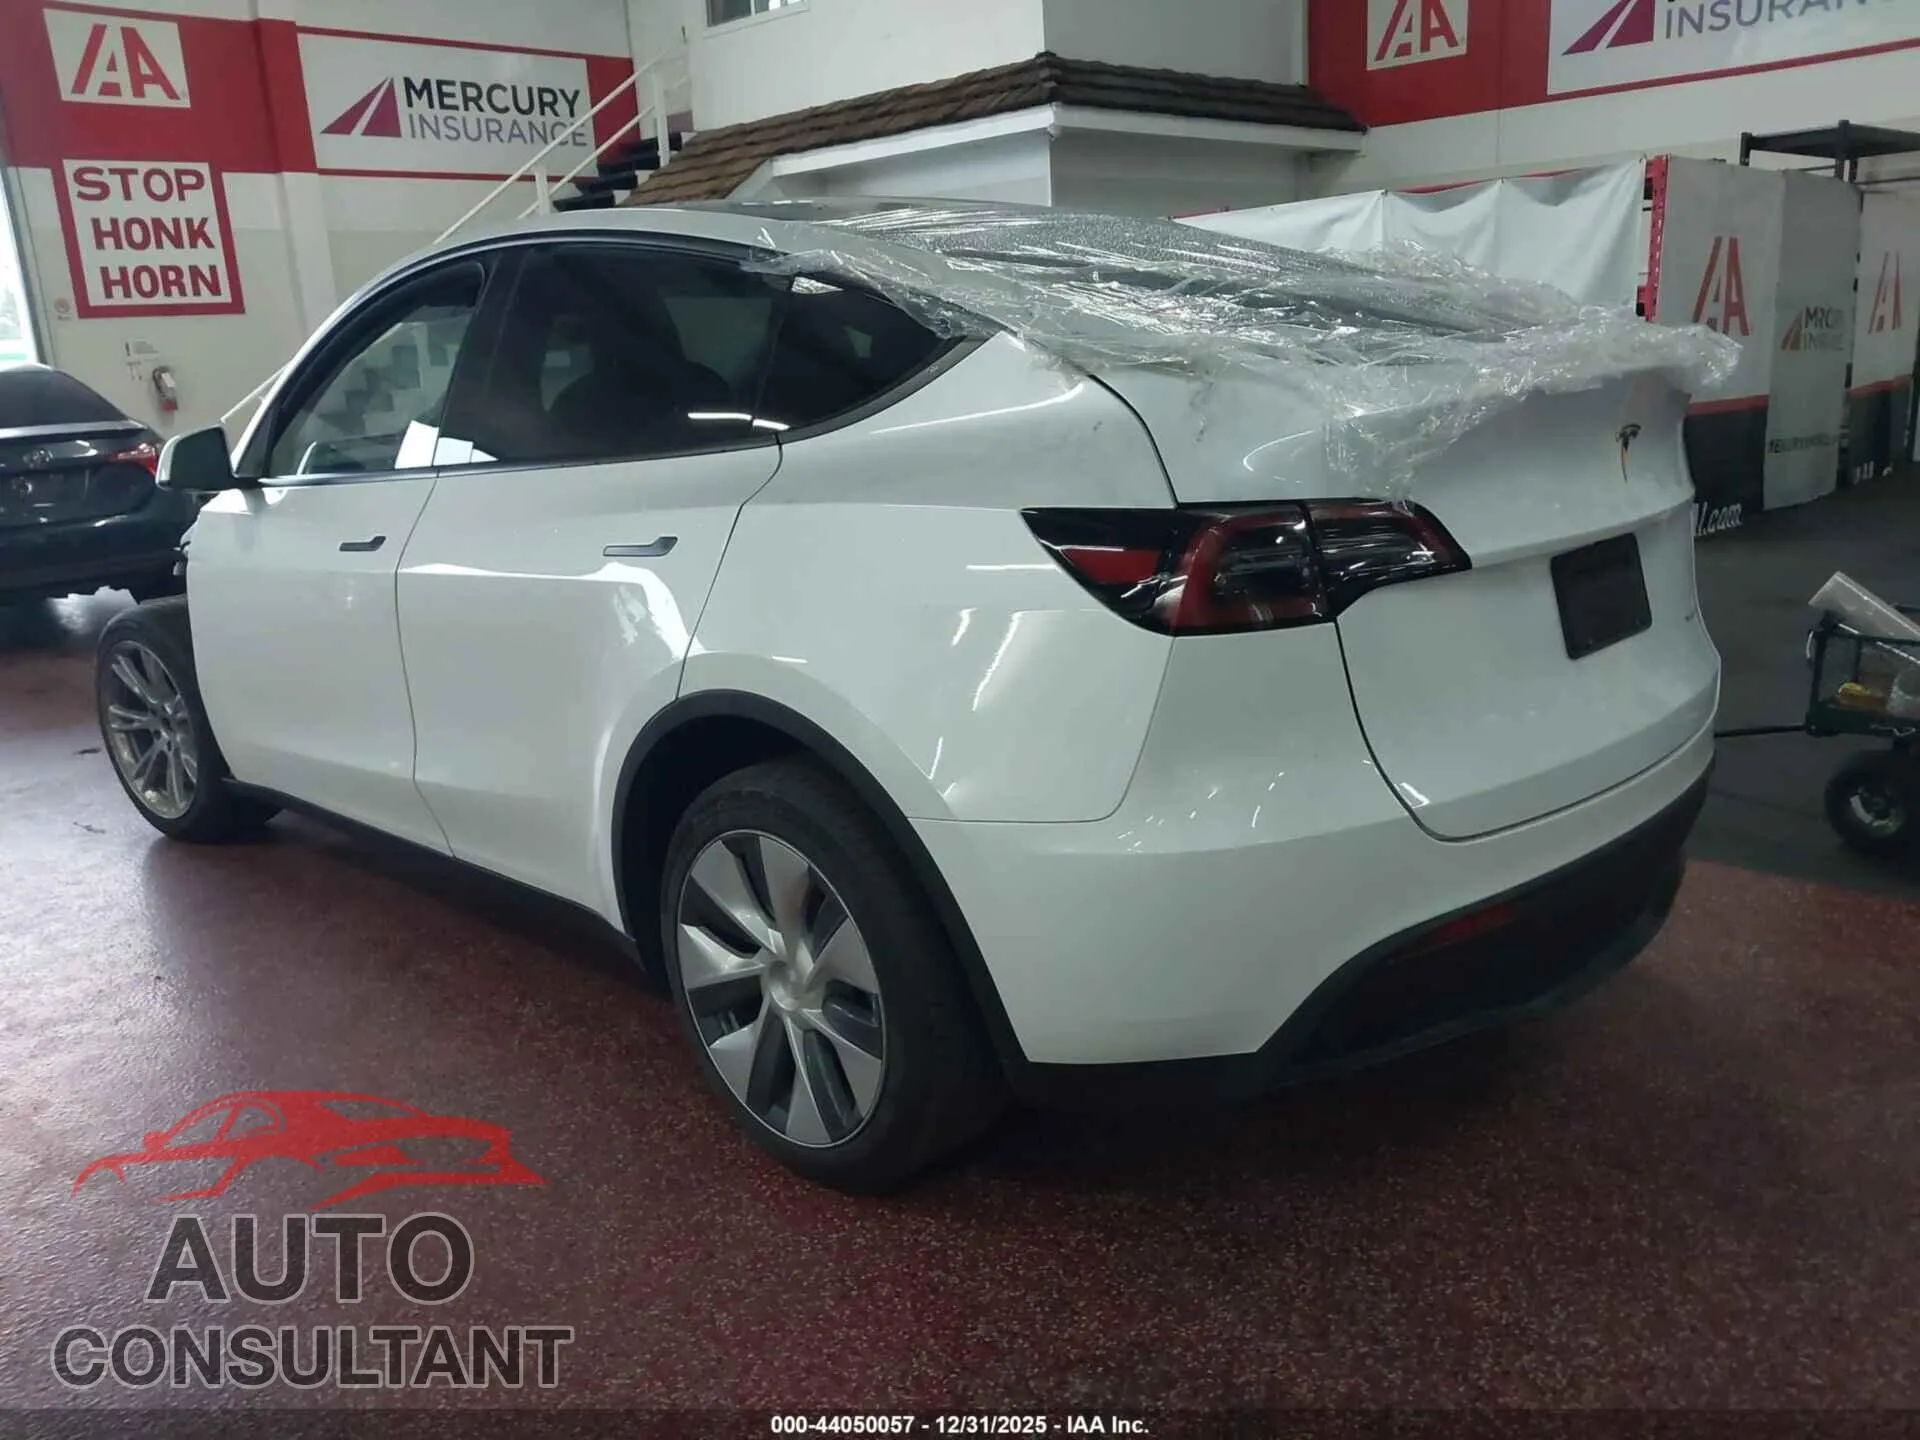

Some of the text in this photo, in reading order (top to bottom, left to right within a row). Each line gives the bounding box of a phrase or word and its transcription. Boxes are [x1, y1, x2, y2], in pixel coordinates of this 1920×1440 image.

[402, 76, 581, 118] MERCURY
[408, 113, 589, 147] INSURANCE
[72, 166, 206, 202] STOP
[90, 217, 216, 251] HONK
[99, 264, 222, 299] HORN
